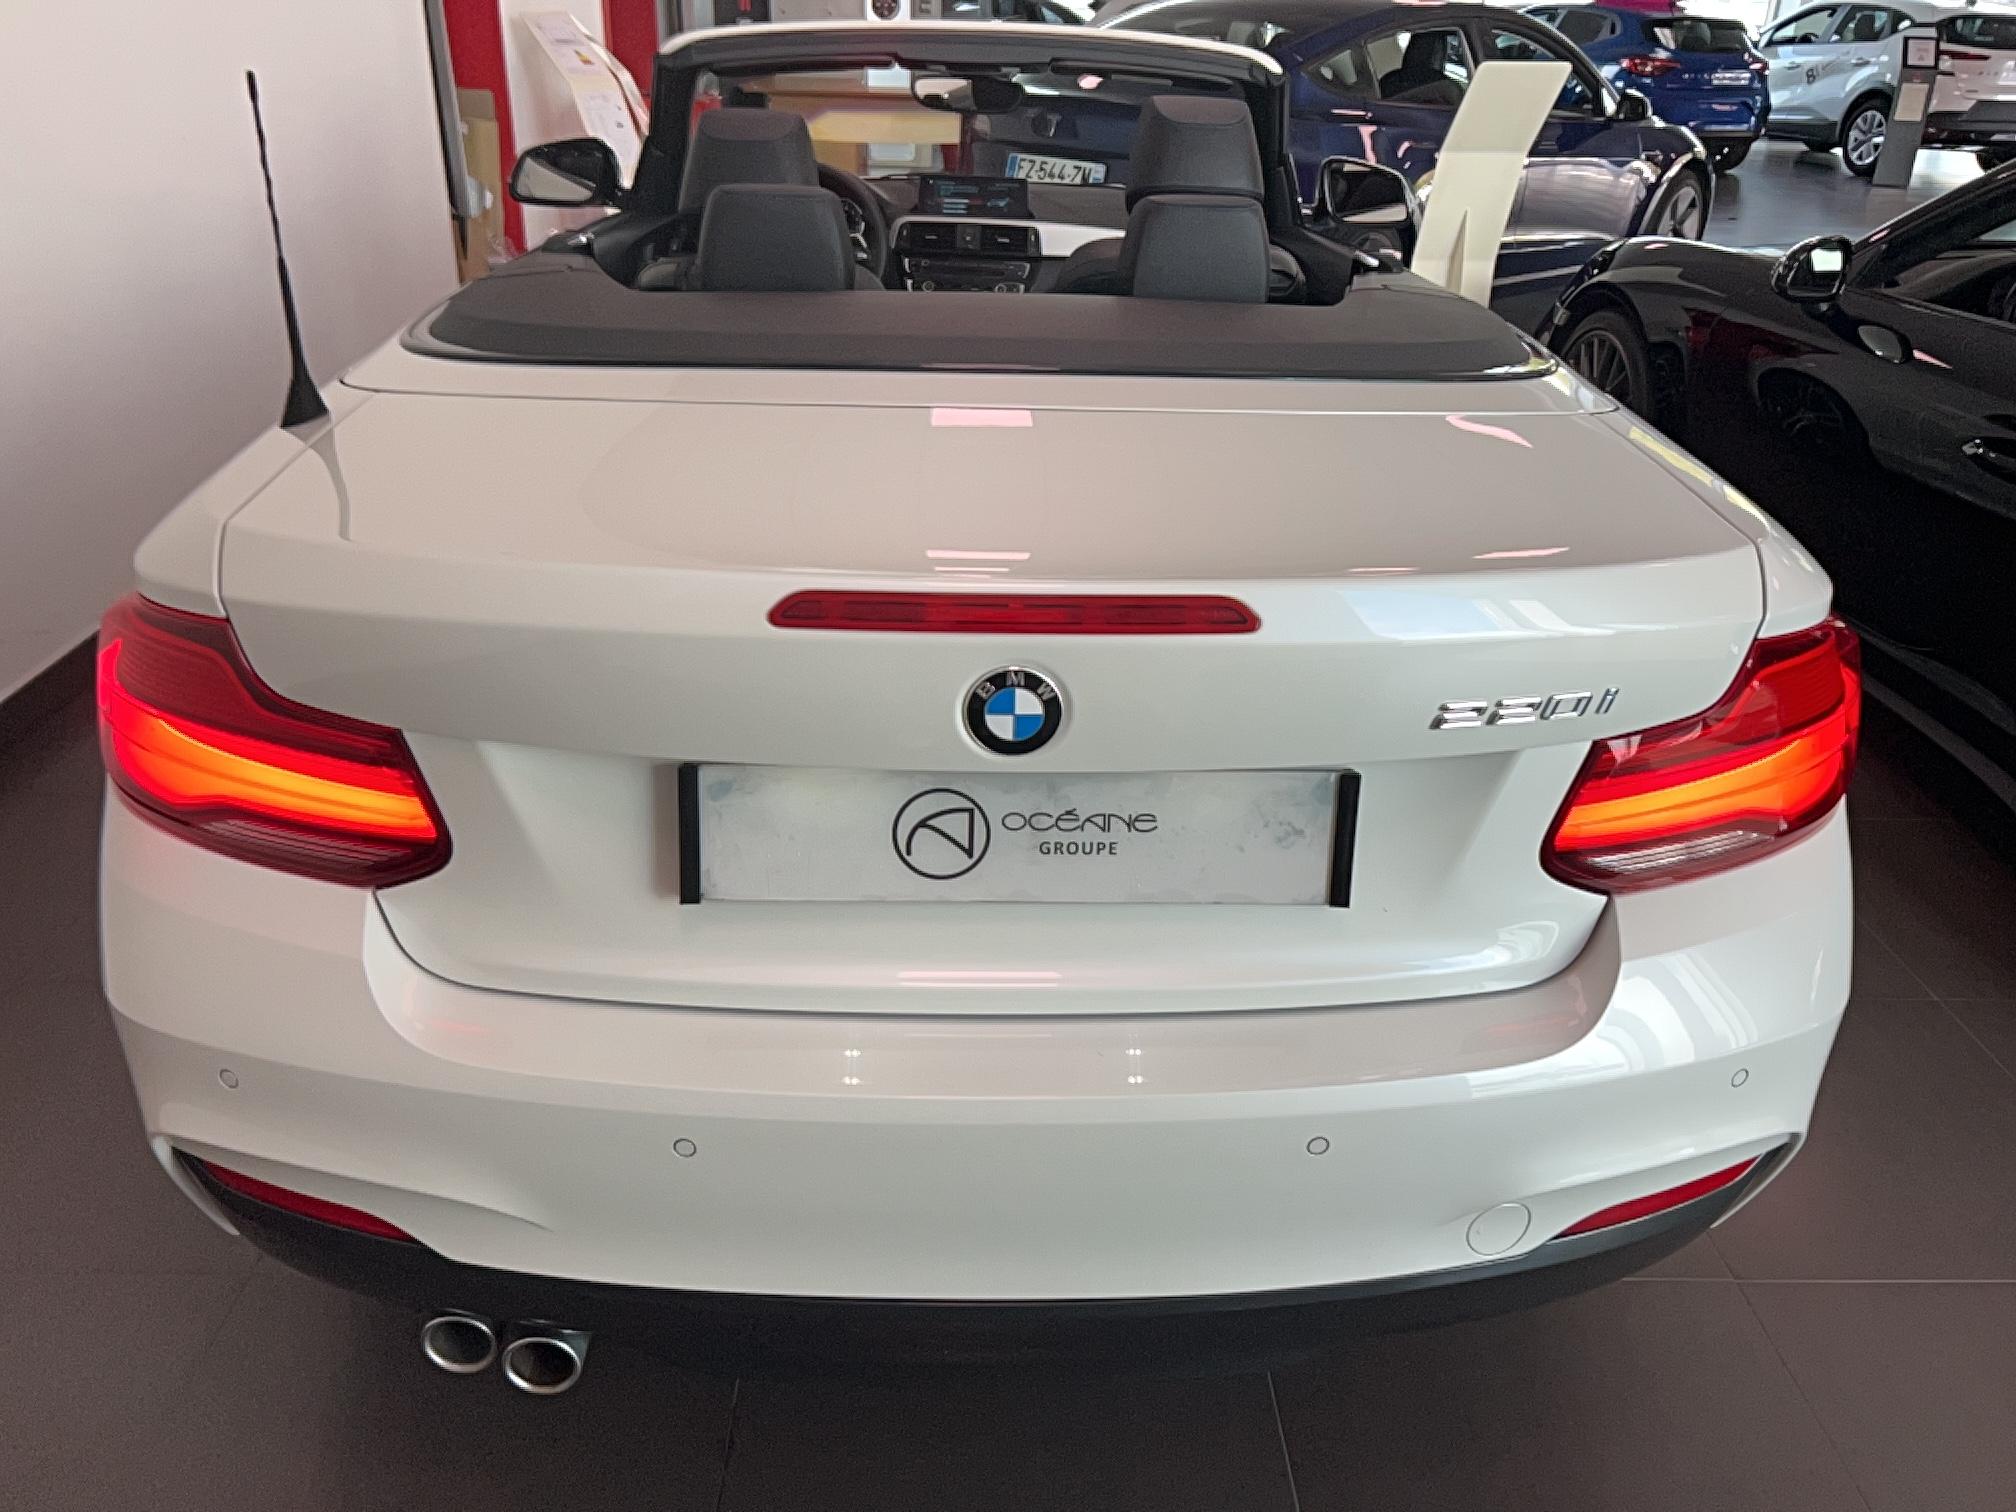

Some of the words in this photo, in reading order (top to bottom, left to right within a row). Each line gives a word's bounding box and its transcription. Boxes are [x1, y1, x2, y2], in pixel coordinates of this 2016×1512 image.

[975, 671, 1056, 701] BMW
[1428, 687, 1620, 729] 220i
[1001, 808, 1158, 833] OCÉANE
[1039, 841, 1118, 856] GROUPE
